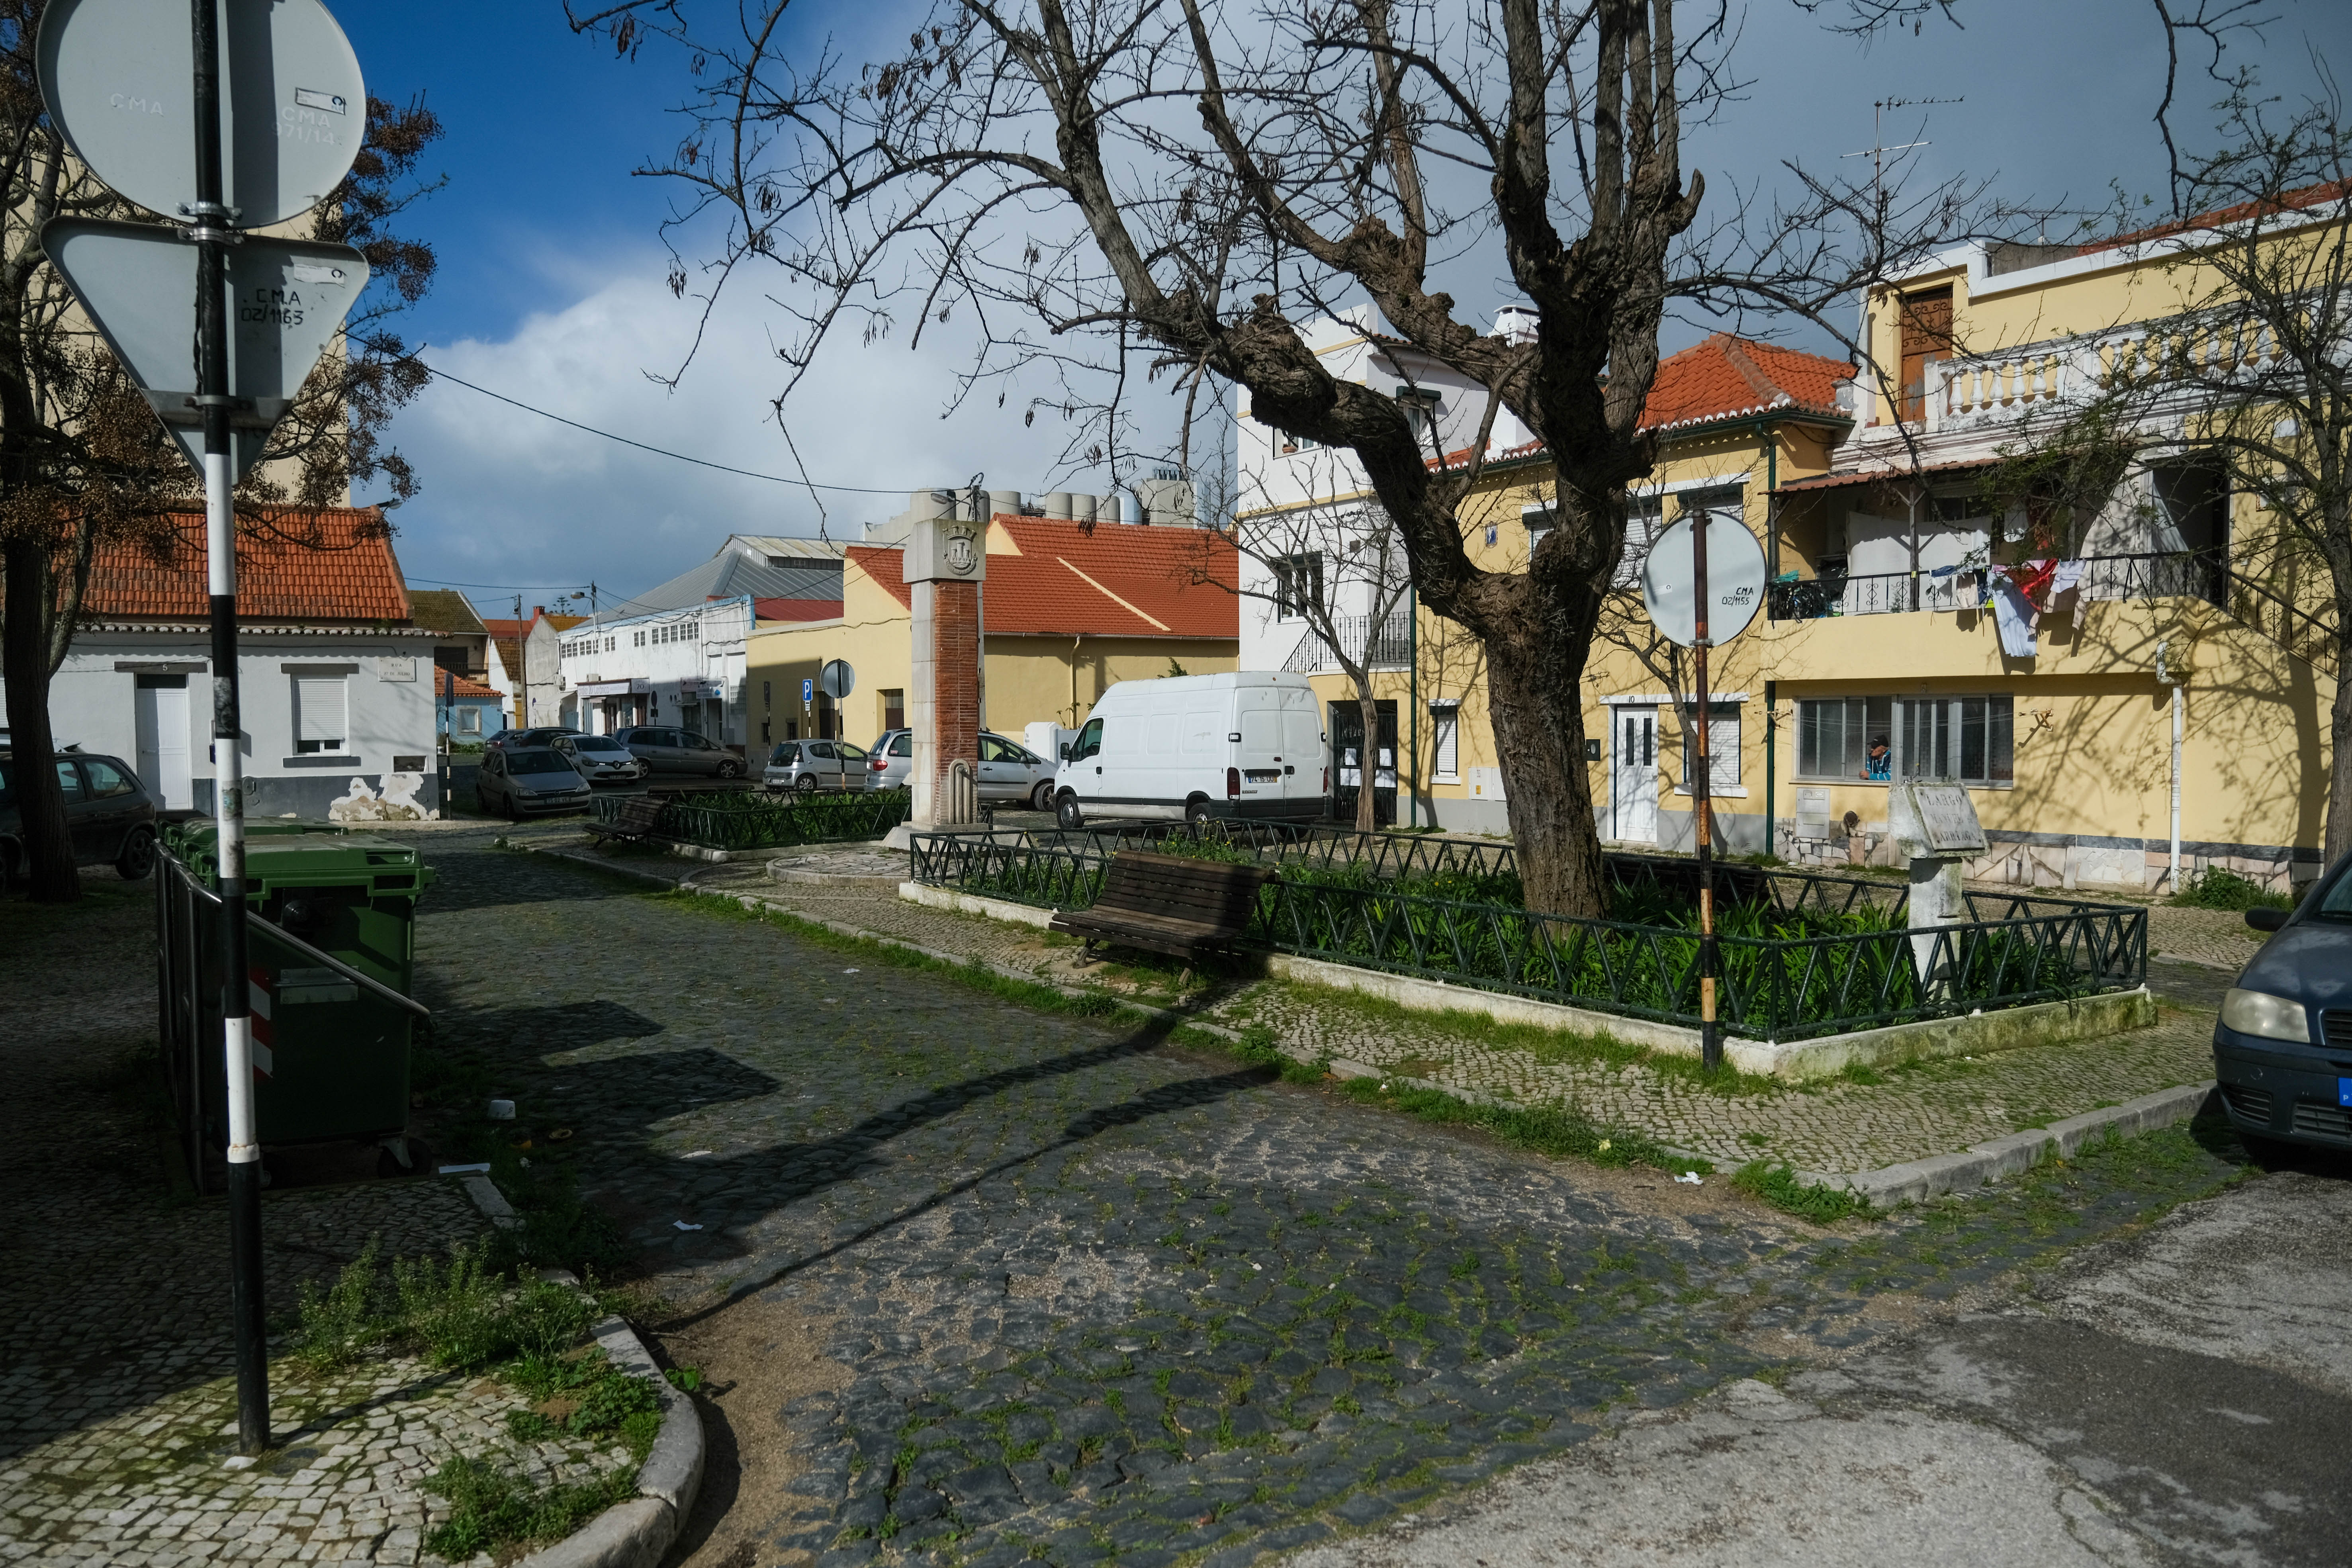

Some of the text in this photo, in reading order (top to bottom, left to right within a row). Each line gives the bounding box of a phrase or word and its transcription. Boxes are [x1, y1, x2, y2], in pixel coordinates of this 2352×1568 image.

[110, 92, 164, 117] CMA
[281, 106, 331, 129] CMA
[804, 682, 810, 699] P
[1925, 794, 1962, 806] LARGO
[1940, 831, 1977, 842] ARRIAGA
